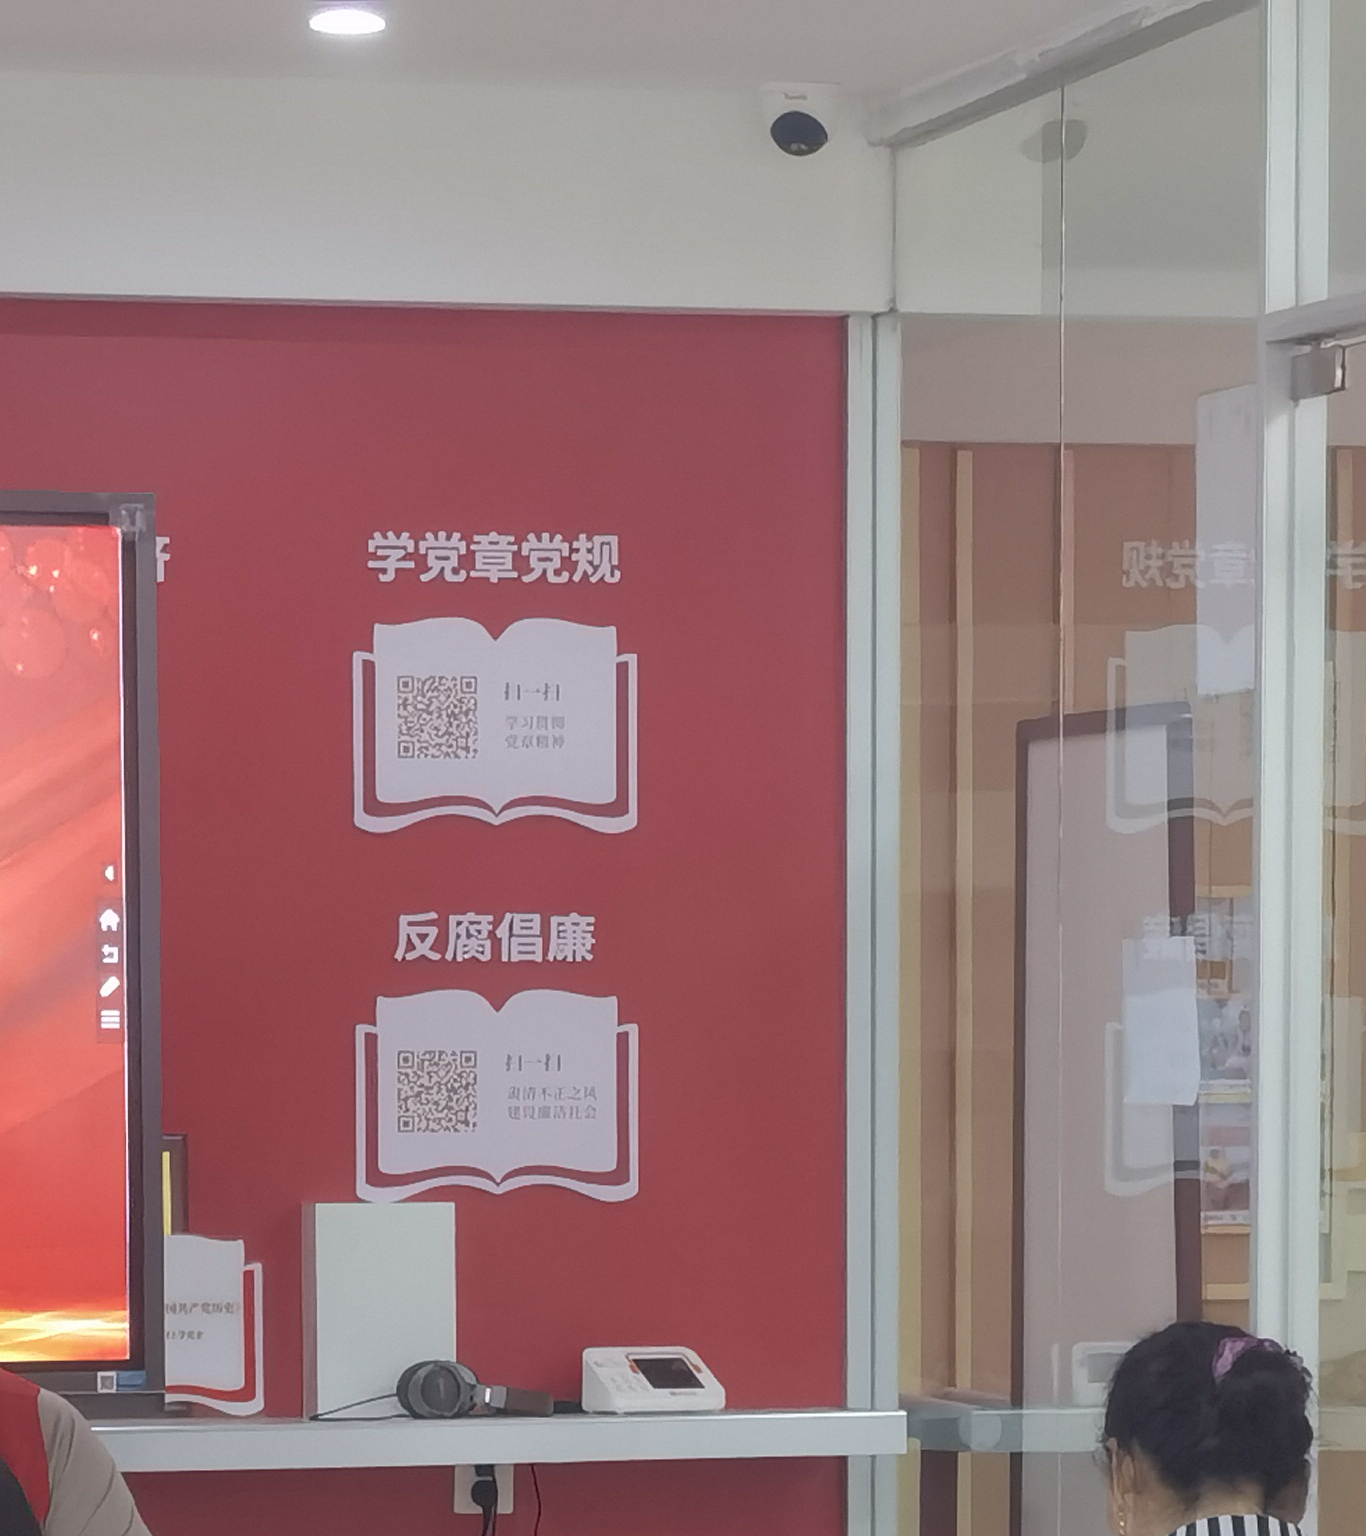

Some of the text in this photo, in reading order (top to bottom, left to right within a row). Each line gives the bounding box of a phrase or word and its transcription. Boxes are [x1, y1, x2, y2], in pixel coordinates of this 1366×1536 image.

[366, 530, 622, 585] 学党章党规
[394, 910, 597, 964] 反腐倡廉
